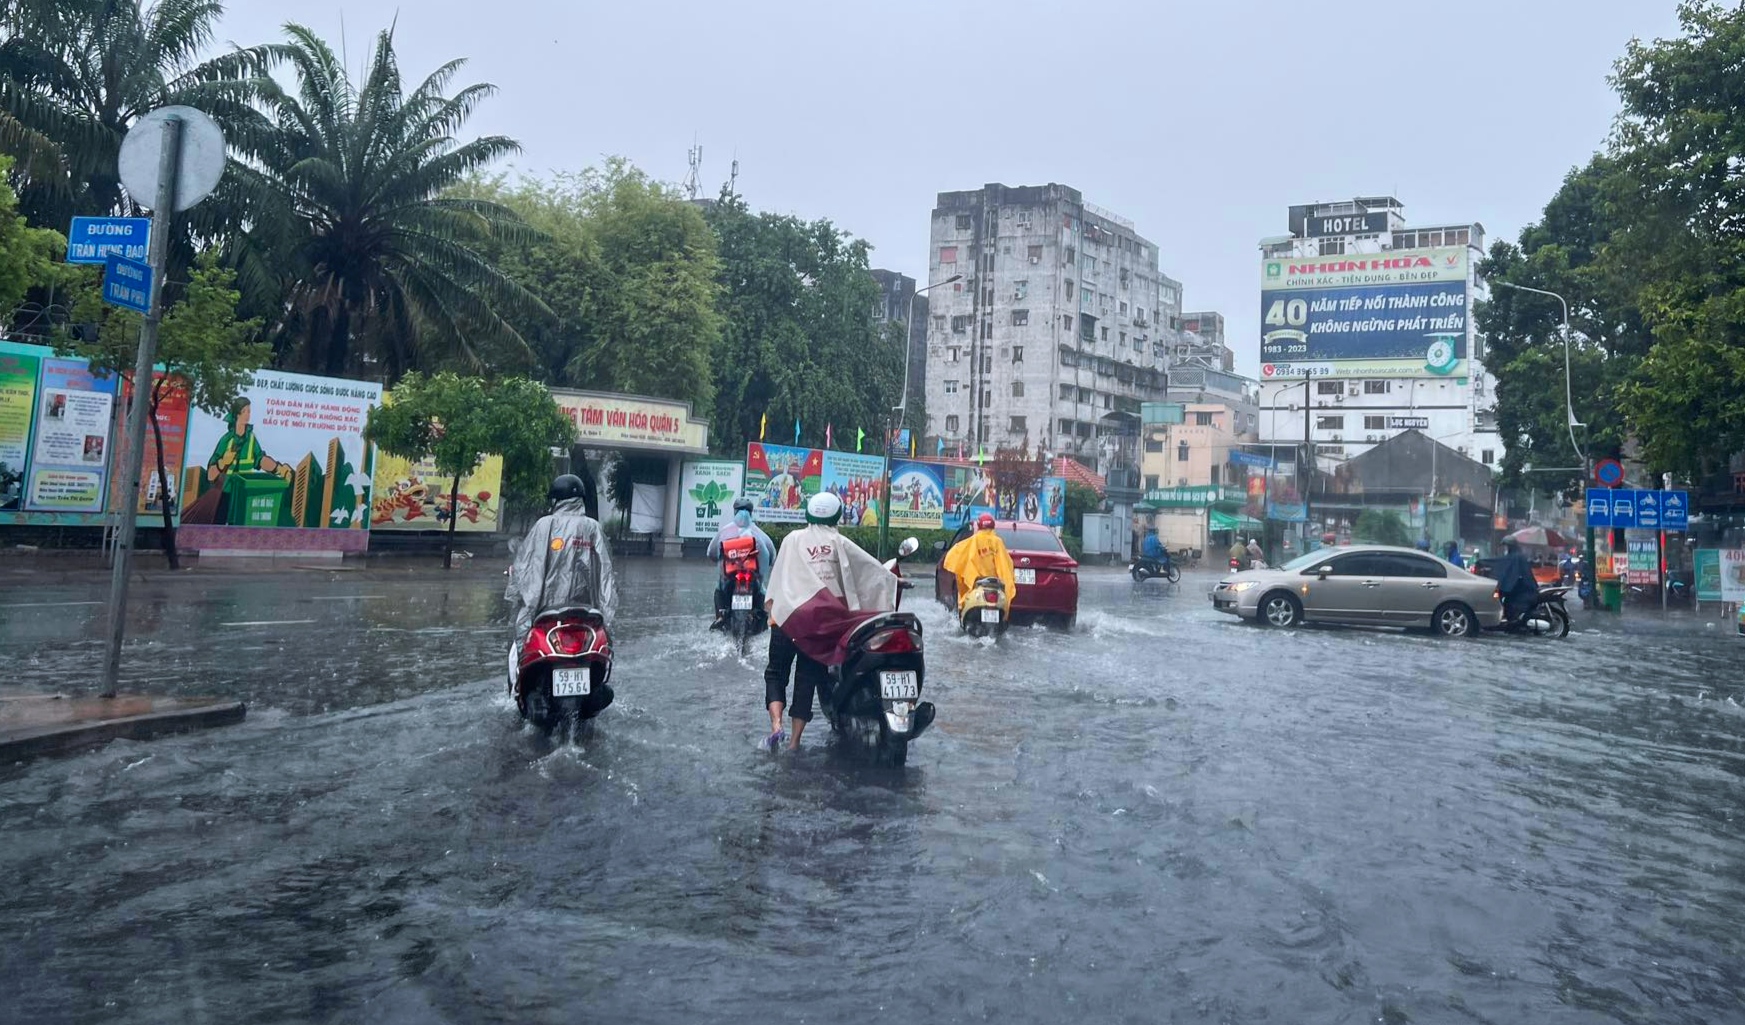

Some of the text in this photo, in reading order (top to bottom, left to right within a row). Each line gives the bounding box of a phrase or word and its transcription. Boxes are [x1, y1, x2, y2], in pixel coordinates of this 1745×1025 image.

[87, 222, 133, 236] ĐƯỜNG
[1323, 217, 1369, 233] HOTEL
[72, 239, 96, 257] TRẦN
[1289, 260, 1368, 275] NHƠN
[1286, 276, 1314, 286] CHÍNH
[1316, 276, 1333, 285] XÁC
[1342, 274, 1361, 283] TIỆN
[1364, 273, 1391, 284] DỤNG
[1400, 271, 1417, 280] BỀN
[1420, 271, 1438, 281] ĐẸP
[1310, 292, 1464, 312] NĂM TIẾP NỐI THÀNH CÔNG
[1265, 298, 1308, 326] 40
[1310, 319, 1350, 333] KHÔNG
[1352, 316, 1395, 331] NGỪNG
[1396, 316, 1428, 330] PHÁT
[1263, 345, 1282, 353] 1983
[1287, 345, 1306, 353] 2023
[270, 378, 285, 389] CHẤT
[286, 381, 304, 392] LƯỢNG
[305, 383, 319, 394] CUỘC
[320, 382, 334, 395] SỐNG
[335, 387, 350, 397] ĐƯỢC
[366, 390, 377, 400] CAO
[287, 399, 303, 408] DÂN
[319, 413, 343, 421] KHÔNG
[580, 404, 604, 426] TÂM
[606, 407, 626, 428] VĂN
[628, 410, 648, 431] HÓA
[674, 417, 680, 433] 5
[885, 673, 911, 684] 59-H1
